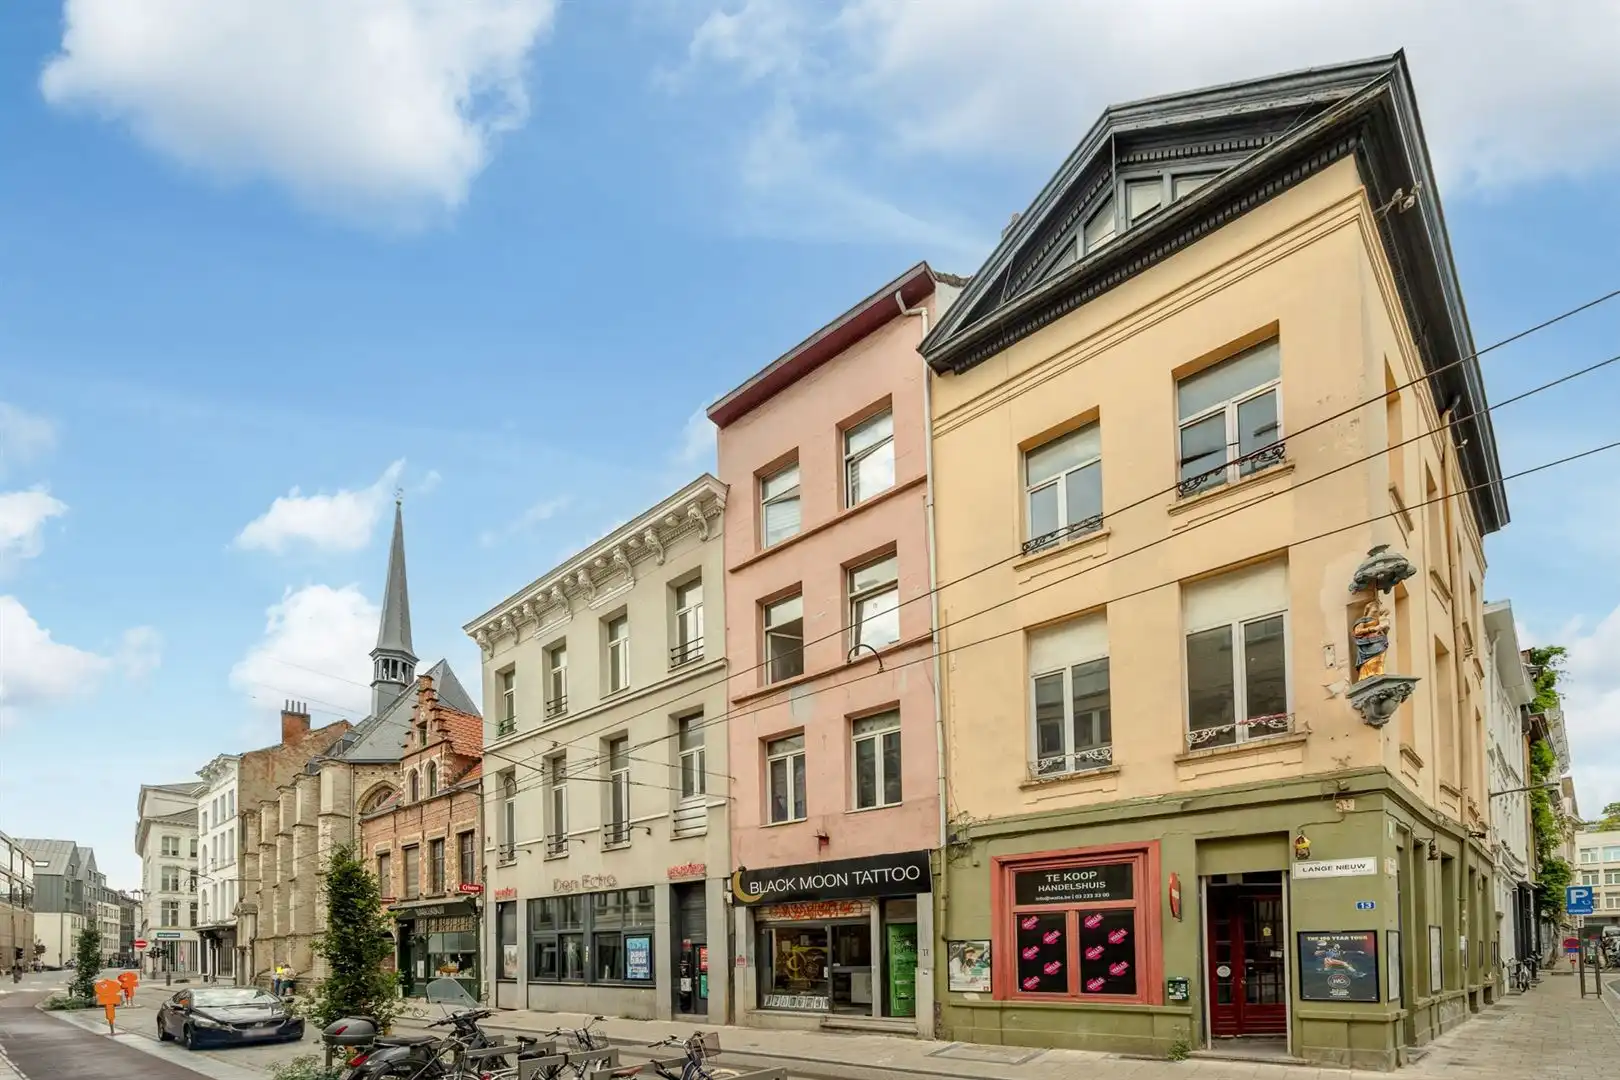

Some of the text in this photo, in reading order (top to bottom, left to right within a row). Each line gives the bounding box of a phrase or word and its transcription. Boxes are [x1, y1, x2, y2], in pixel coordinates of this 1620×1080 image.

[1302, 865, 1333, 873] LANGE
[1336, 863, 1366, 871] NIEUW
[750, 865, 921, 895] BLACK MOON TATTOO
[1045, 871, 1098, 883] TE KOOP
[1038, 881, 1107, 892] HANDELSHUIS
[1570, 888, 1589, 905] P
[1360, 901, 1372, 910] 13
